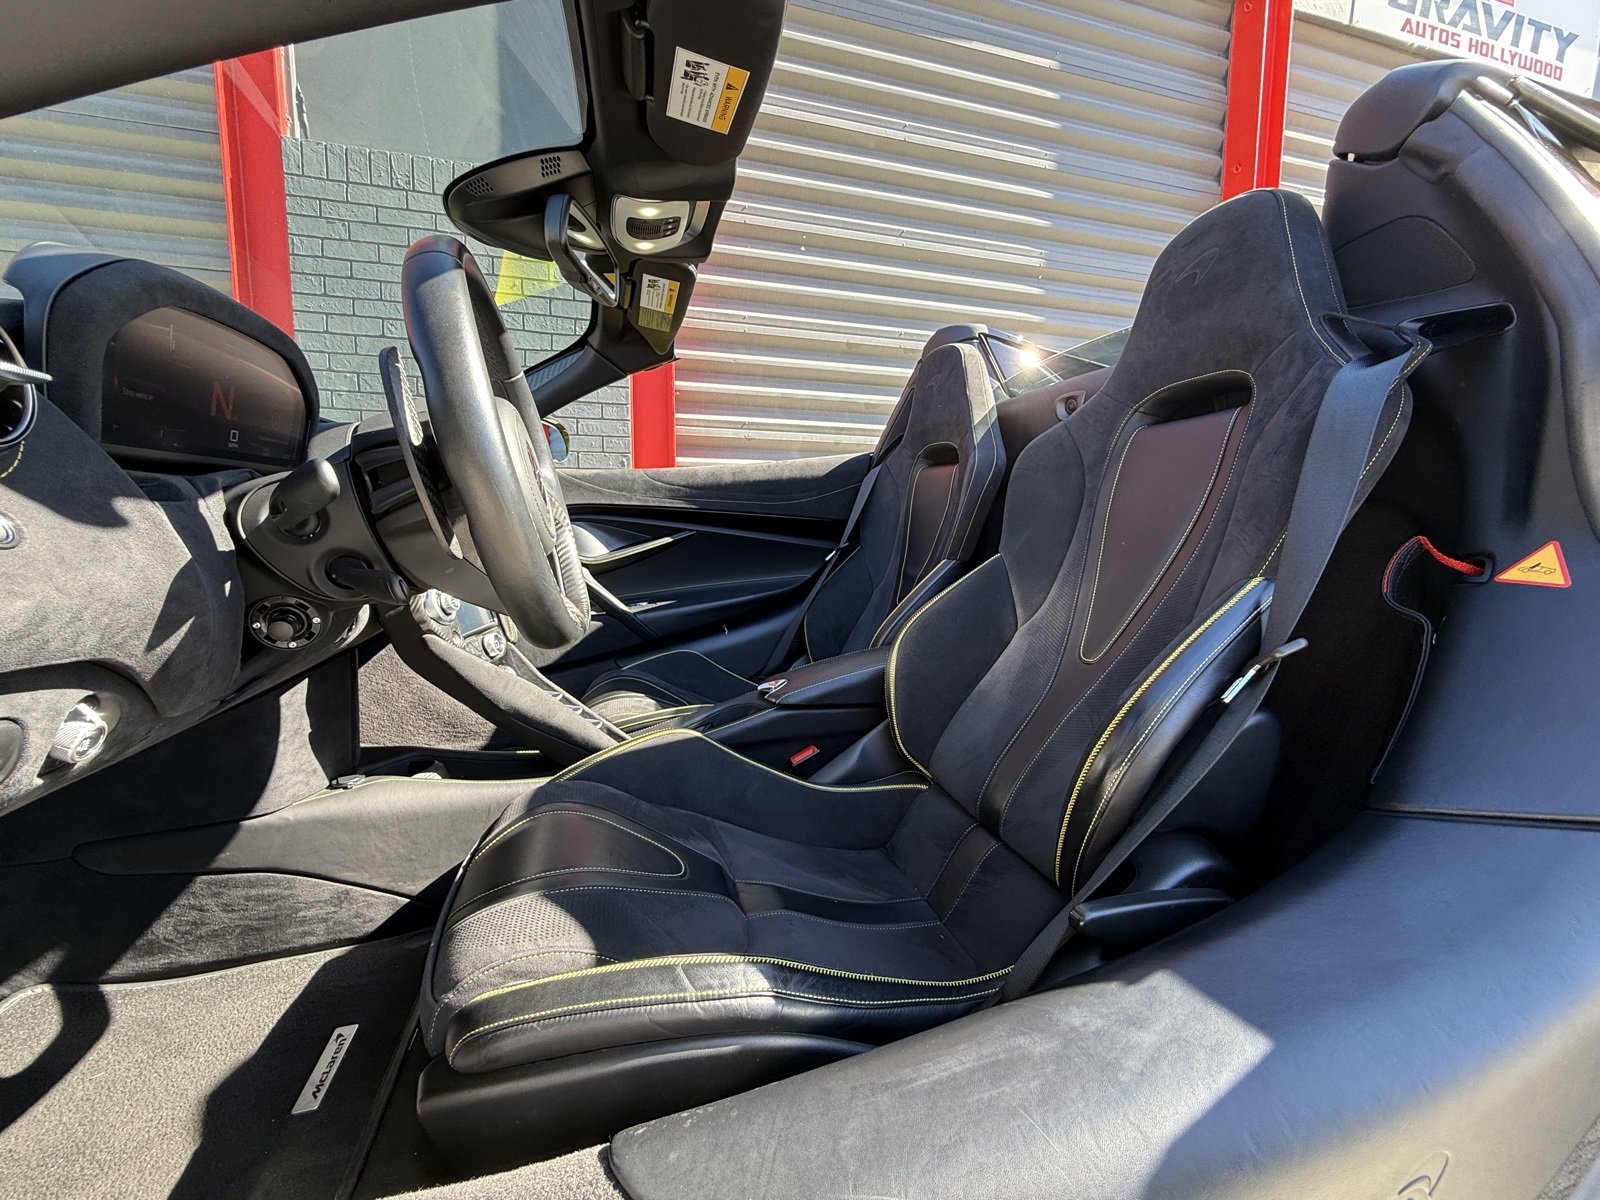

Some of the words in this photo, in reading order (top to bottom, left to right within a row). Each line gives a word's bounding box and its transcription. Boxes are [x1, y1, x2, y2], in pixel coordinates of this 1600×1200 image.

[1400, 17, 1462, 49] AUTOS
[1468, 37, 1563, 81] HOLLYWOOD
[719, 96, 732, 120] WARNING
[210, 382, 235, 420] N
[311, 1037, 347, 1100] McLaren
